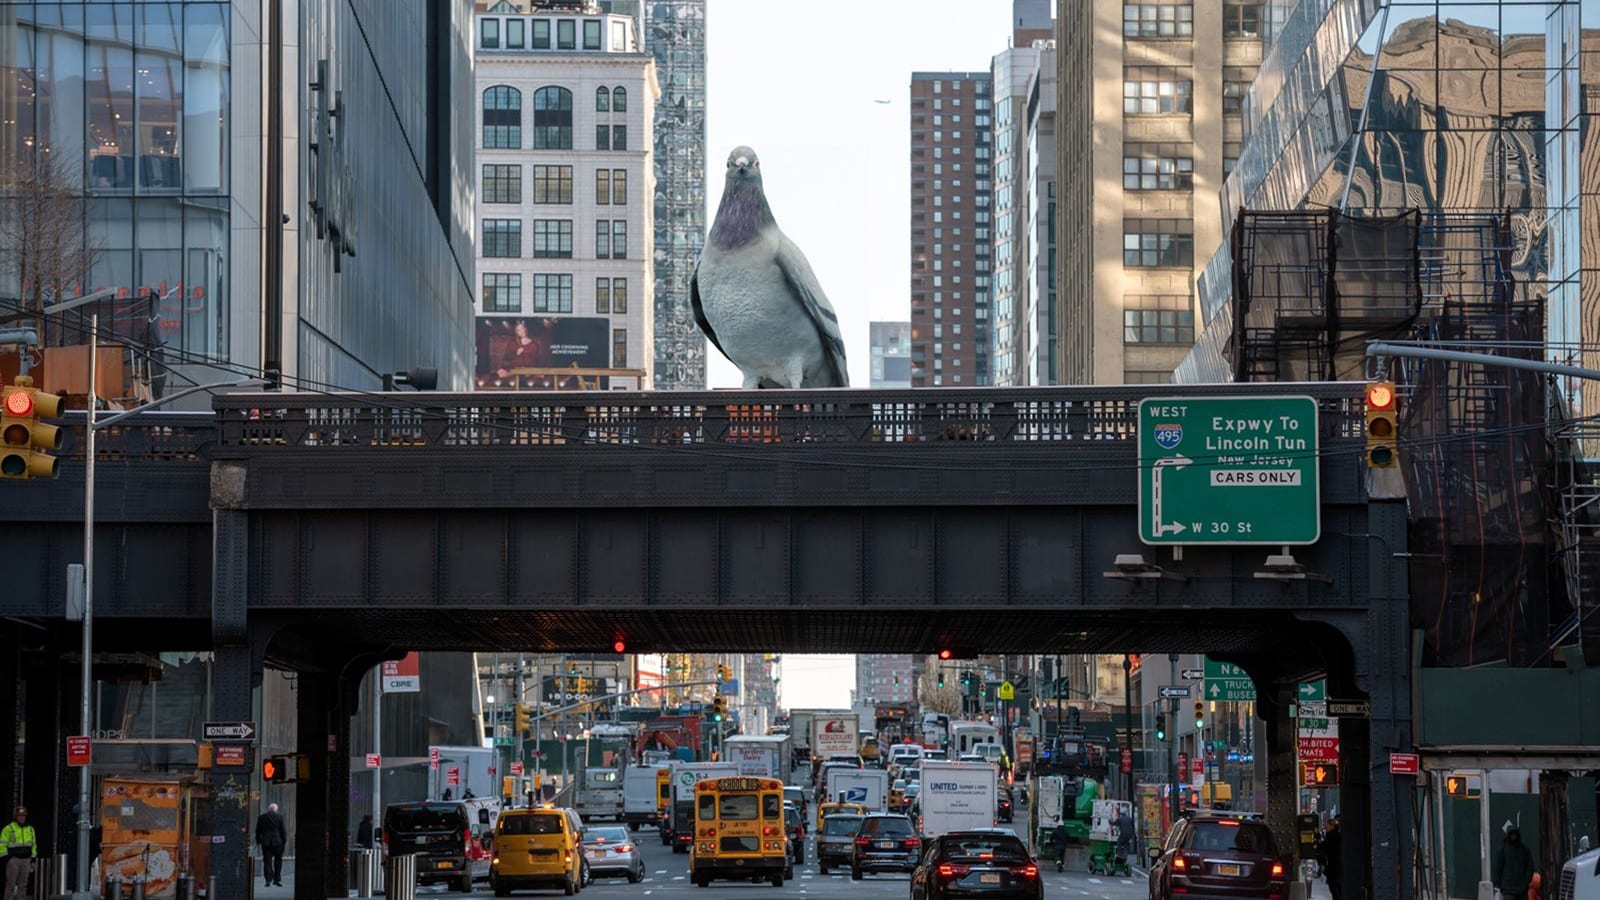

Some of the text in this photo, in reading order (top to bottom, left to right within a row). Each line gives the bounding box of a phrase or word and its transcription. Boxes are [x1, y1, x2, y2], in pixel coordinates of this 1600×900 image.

[1149, 406, 1187, 417] WEST
[1212, 416, 1299, 433] Expwy To
[1157, 431, 1179, 442] 495
[1206, 436, 1305, 450] Lincoln Tun
[1217, 454, 1293, 467] New Jersey
[1216, 472, 1296, 483] CARS ONLY
[1192, 522, 1251, 533] W 30 St
[1227, 691, 1257, 699] BUSES
[1334, 705, 1348, 713] ONE
[232, 727, 248, 735] WAY
[930, 783, 958, 791] UNITED
